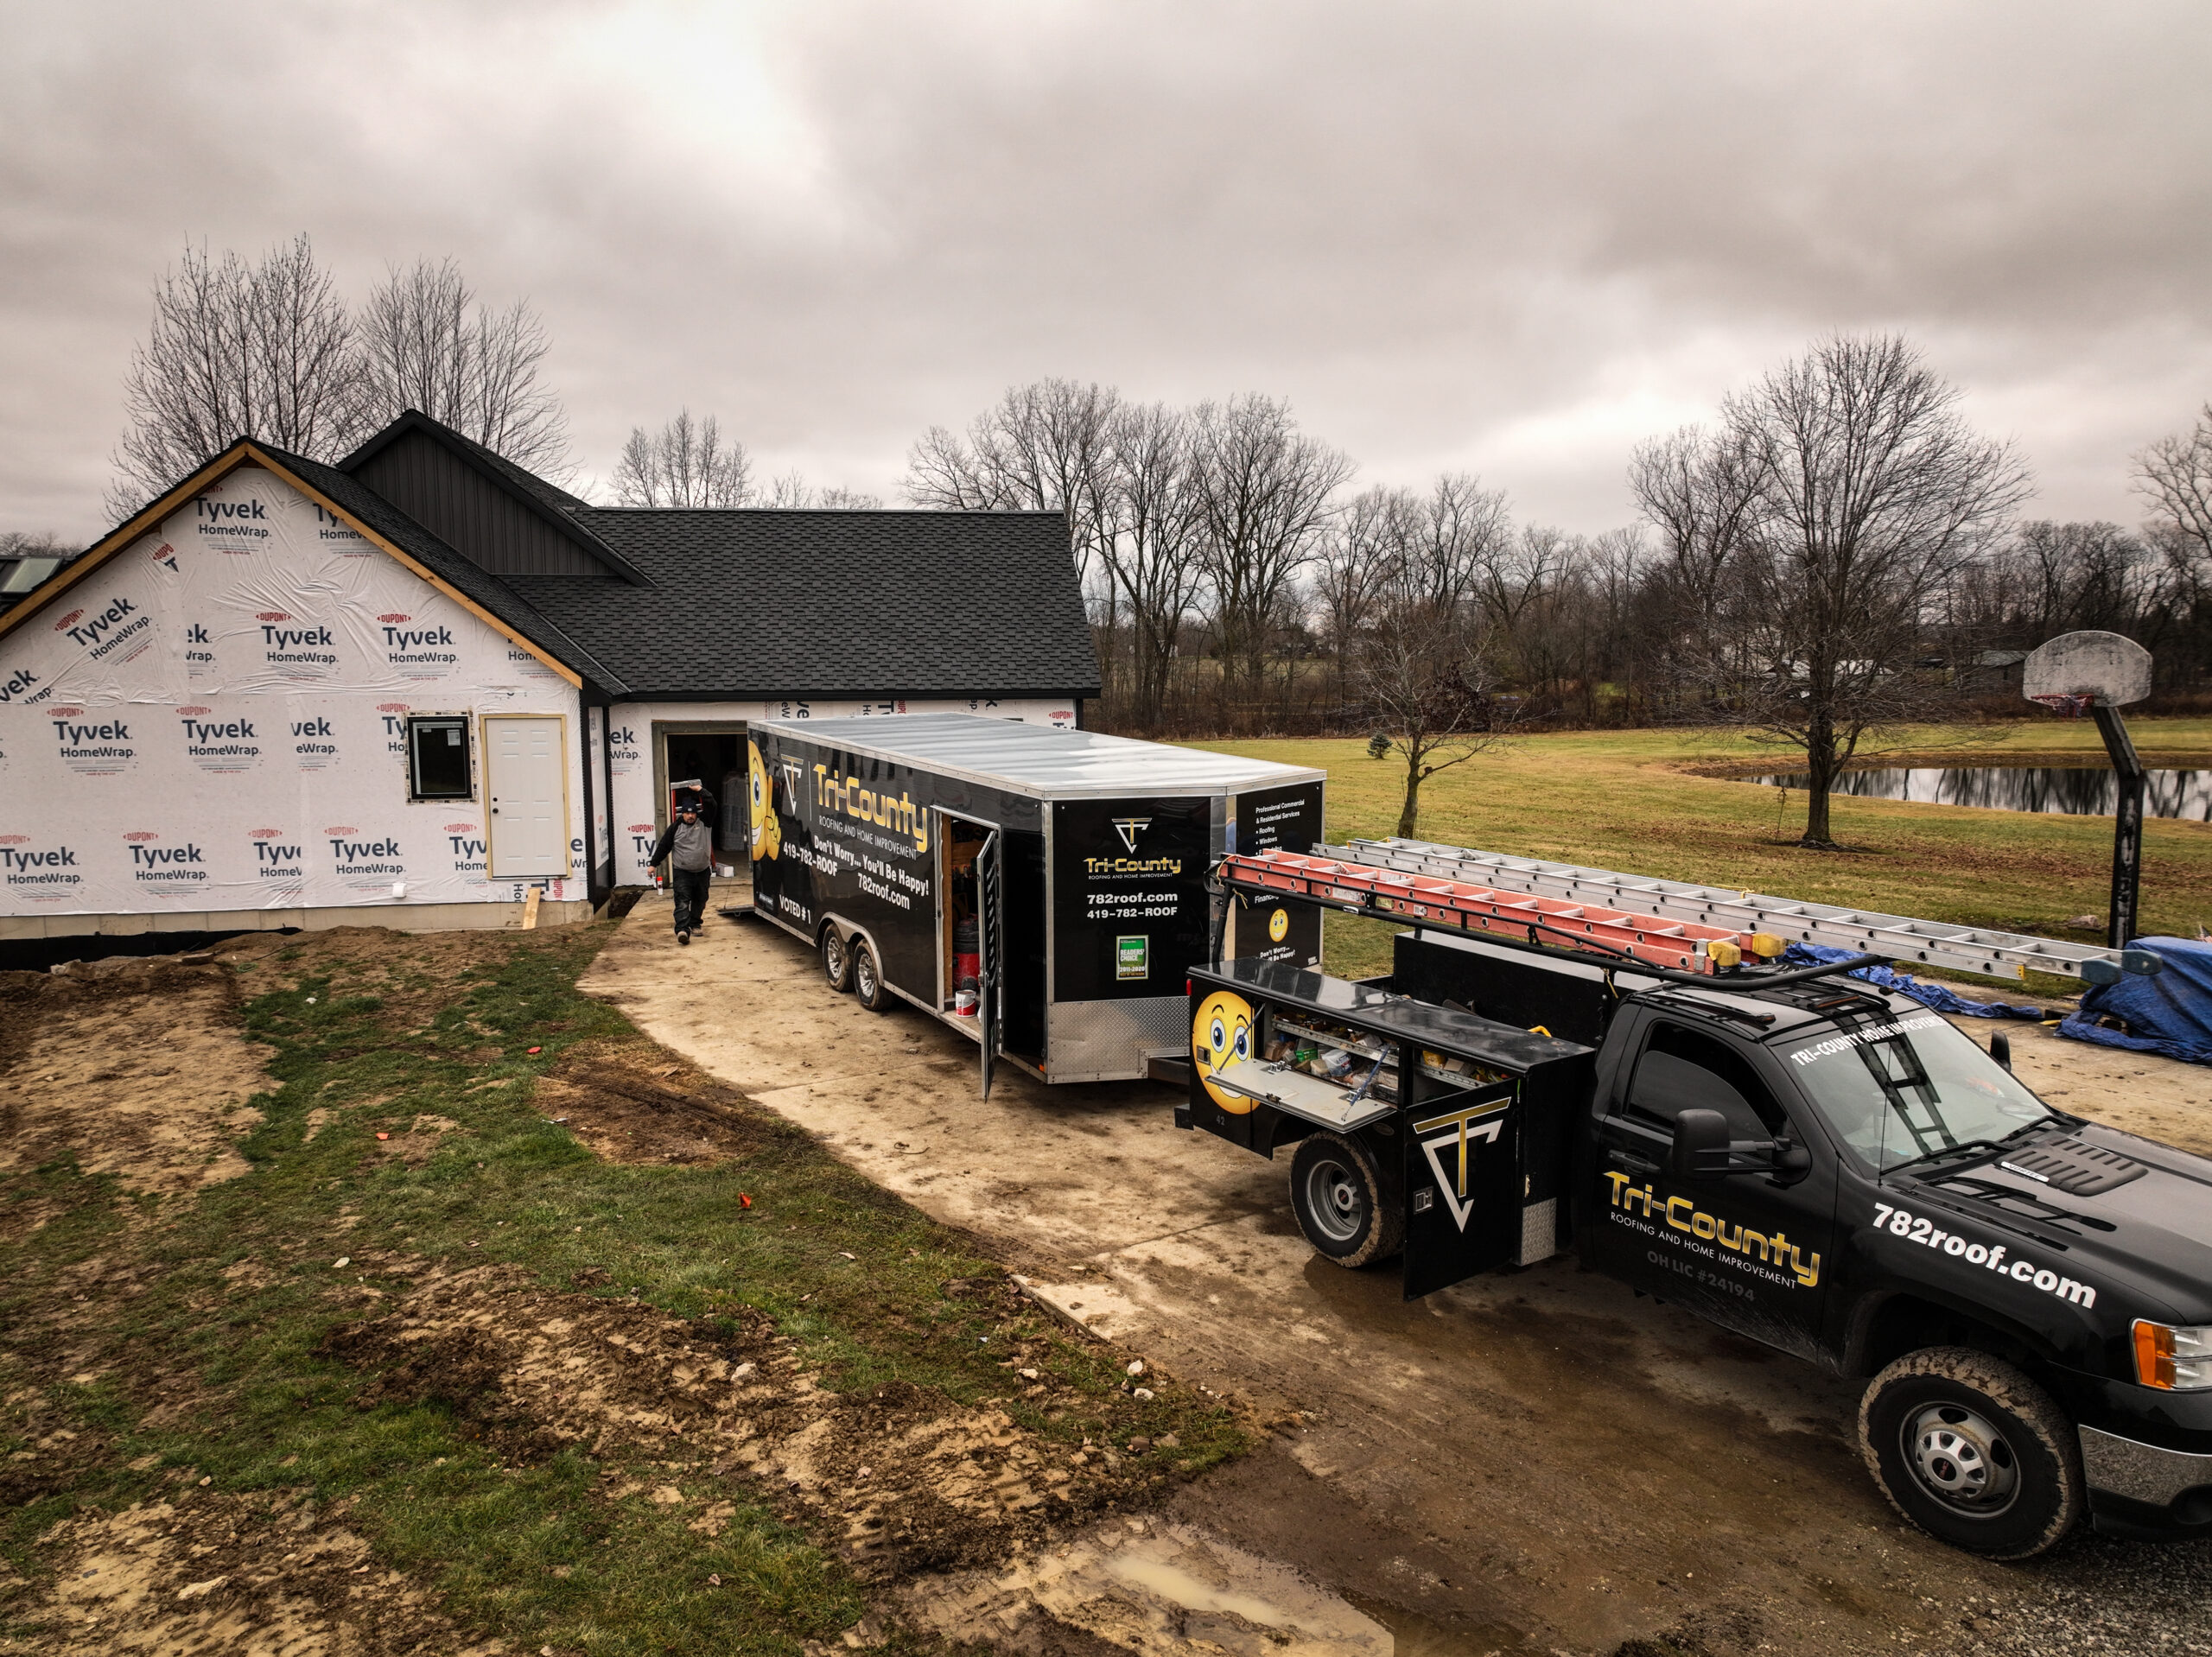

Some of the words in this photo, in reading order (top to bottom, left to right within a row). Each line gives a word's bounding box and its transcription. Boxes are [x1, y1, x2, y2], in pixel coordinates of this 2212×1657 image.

[194, 497, 265, 522] Tyvek
[199, 524, 269, 538] HomeWrap
[57, 610, 83, 630] DUPONT
[67, 598, 136, 646] Tyvek
[260, 613, 287, 621] DUPONT
[381, 613, 408, 623] DUPONT
[90, 616, 149, 660] HomeWrap
[261, 625, 333, 650] Tyvek
[382, 625, 453, 651] Tyvek
[267, 651, 336, 664] HomeWrap
[389, 651, 456, 663] HomeWrap
[51, 708, 79, 717] DUPONT
[180, 706, 207, 715] DUPONT
[380, 703, 406, 712] DUPONT
[53, 721, 130, 746] Tyvek
[181, 719, 255, 743] Tyvek
[60, 747, 133, 759] HomeWrap
[188, 745, 259, 757] HomeWrap
[813, 764, 927, 853] Tri-County
[1255, 803, 1281, 814] Professional
[1281, 799, 1305, 809] Commercial
[1259, 812, 1281, 824] Residential
[1281, 810, 1300, 820] Services
[251, 828, 279, 838] DUPONT
[327, 826, 355, 835] DUPONT
[448, 823, 473, 833] DUPONT
[631, 824, 654, 833] DUPONT
[1259, 826, 1275, 835] Roofing
[127, 832, 155, 841] DUPONT
[819, 816, 843, 833] ROOFING
[844, 824, 856, 838] AND
[857, 827, 874, 845] HOME
[874, 835, 918, 860] IMPROVEMENT
[1259, 836, 1278, 845] Windows
[129, 843, 202, 868] Tyvek
[329, 838, 400, 862] Tyvek
[0, 847, 76, 872] Tyvek
[784, 841, 838, 877] 419-782-ROOF
[814, 835, 833, 855] Don't
[833, 842, 861, 867] Worry...
[862, 854, 884, 877] You'll
[886, 864, 897, 882] Be
[899, 868, 929, 896] Happy!
[1083, 857, 1181, 874] Tri-County
[136, 870, 207, 881] HomeWrap
[336, 864, 404, 874] HomeWrap
[7, 873, 80, 885] HomeWrap
[857, 873, 910, 910] 782roof.com
[1087, 892, 1179, 905] 782roof.com
[779, 894, 801, 918] VOTED
[1087, 906, 1178, 919] 419-782-ROOF
[1790, 1032, 1864, 1066] TRI-COUNTY
[1861, 1025, 1896, 1042] HOME
[1603, 1171, 1821, 1287] Tri-County
[1611, 1211, 1656, 1236] ROOFING
[1658, 1229, 1681, 1246] AND
[1684, 1239, 1715, 1259] HOME
[1719, 1252, 1796, 1290] IMPROVEMENT
[1872, 1203, 2097, 1309] 782roof.com
[1647, 1250, 1669, 1268] OH
[1672, 1257, 1694, 1278] LIC
[1697, 1268, 1755, 1302] #24194
